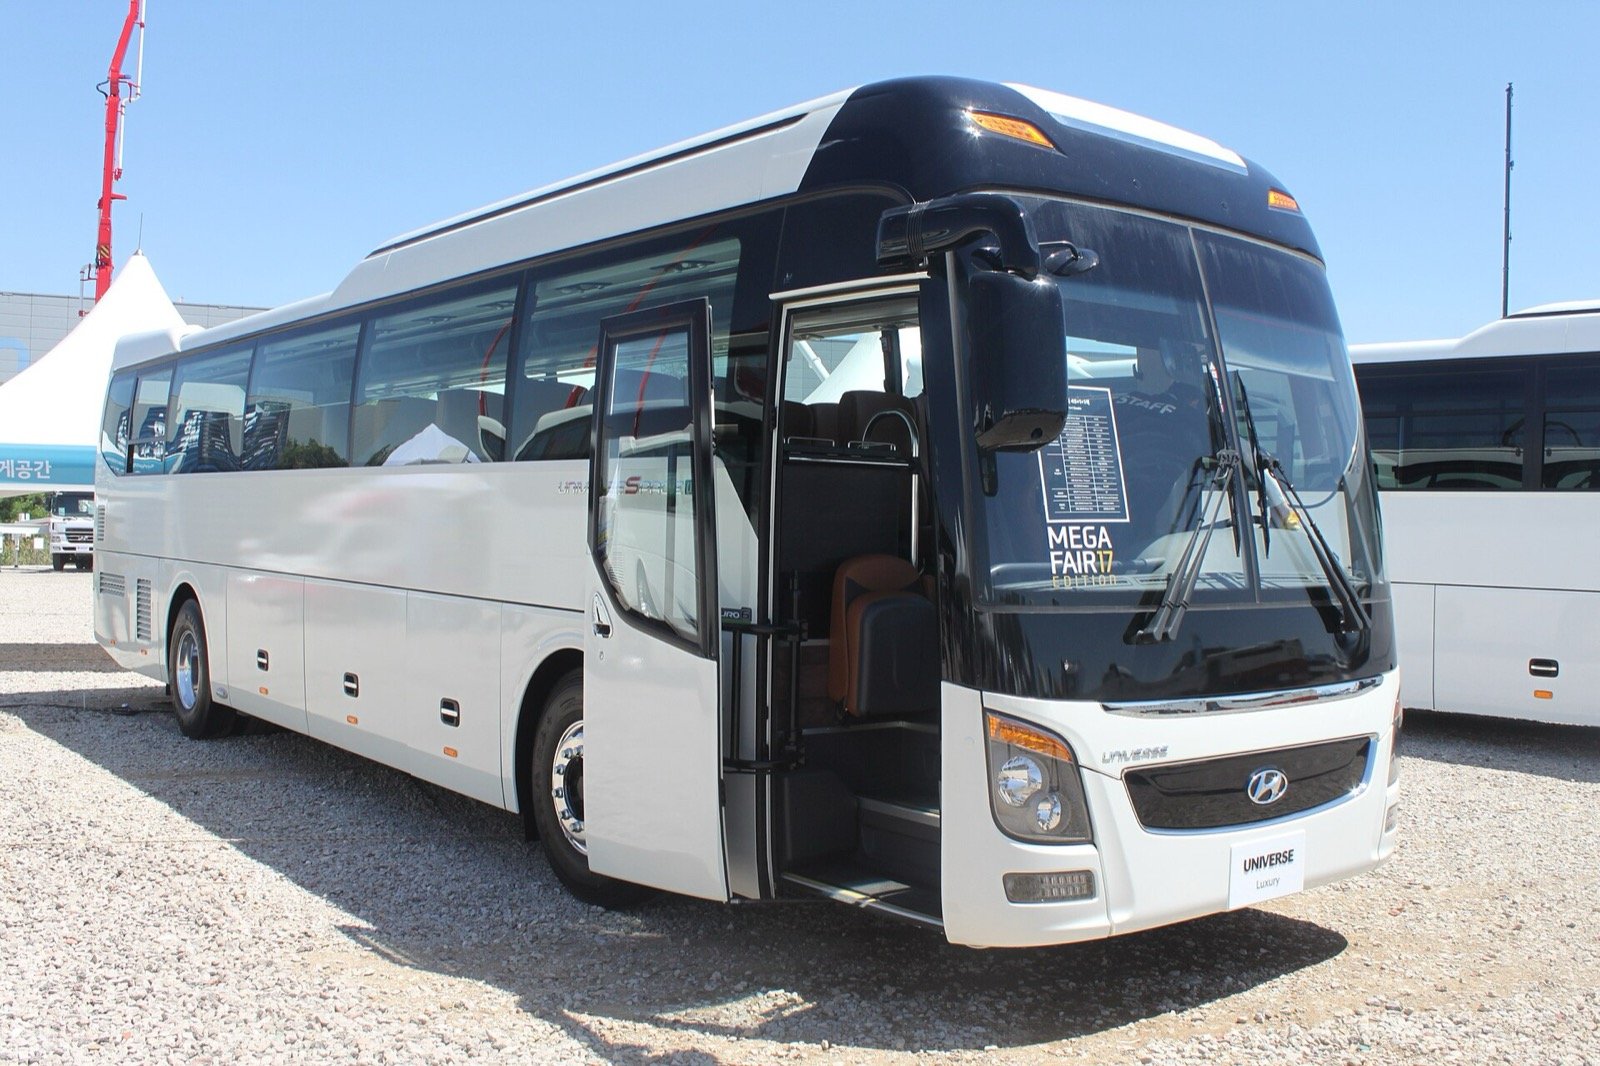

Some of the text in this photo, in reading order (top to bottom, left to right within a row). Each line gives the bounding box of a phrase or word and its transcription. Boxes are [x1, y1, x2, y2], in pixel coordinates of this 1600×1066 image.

[1116, 394, 1176, 415] STAFF
[1047, 526, 1113, 549] MEGA
[1243, 849, 1295, 872] UNIVERSE
[1256, 877, 1281, 890] Luxury
